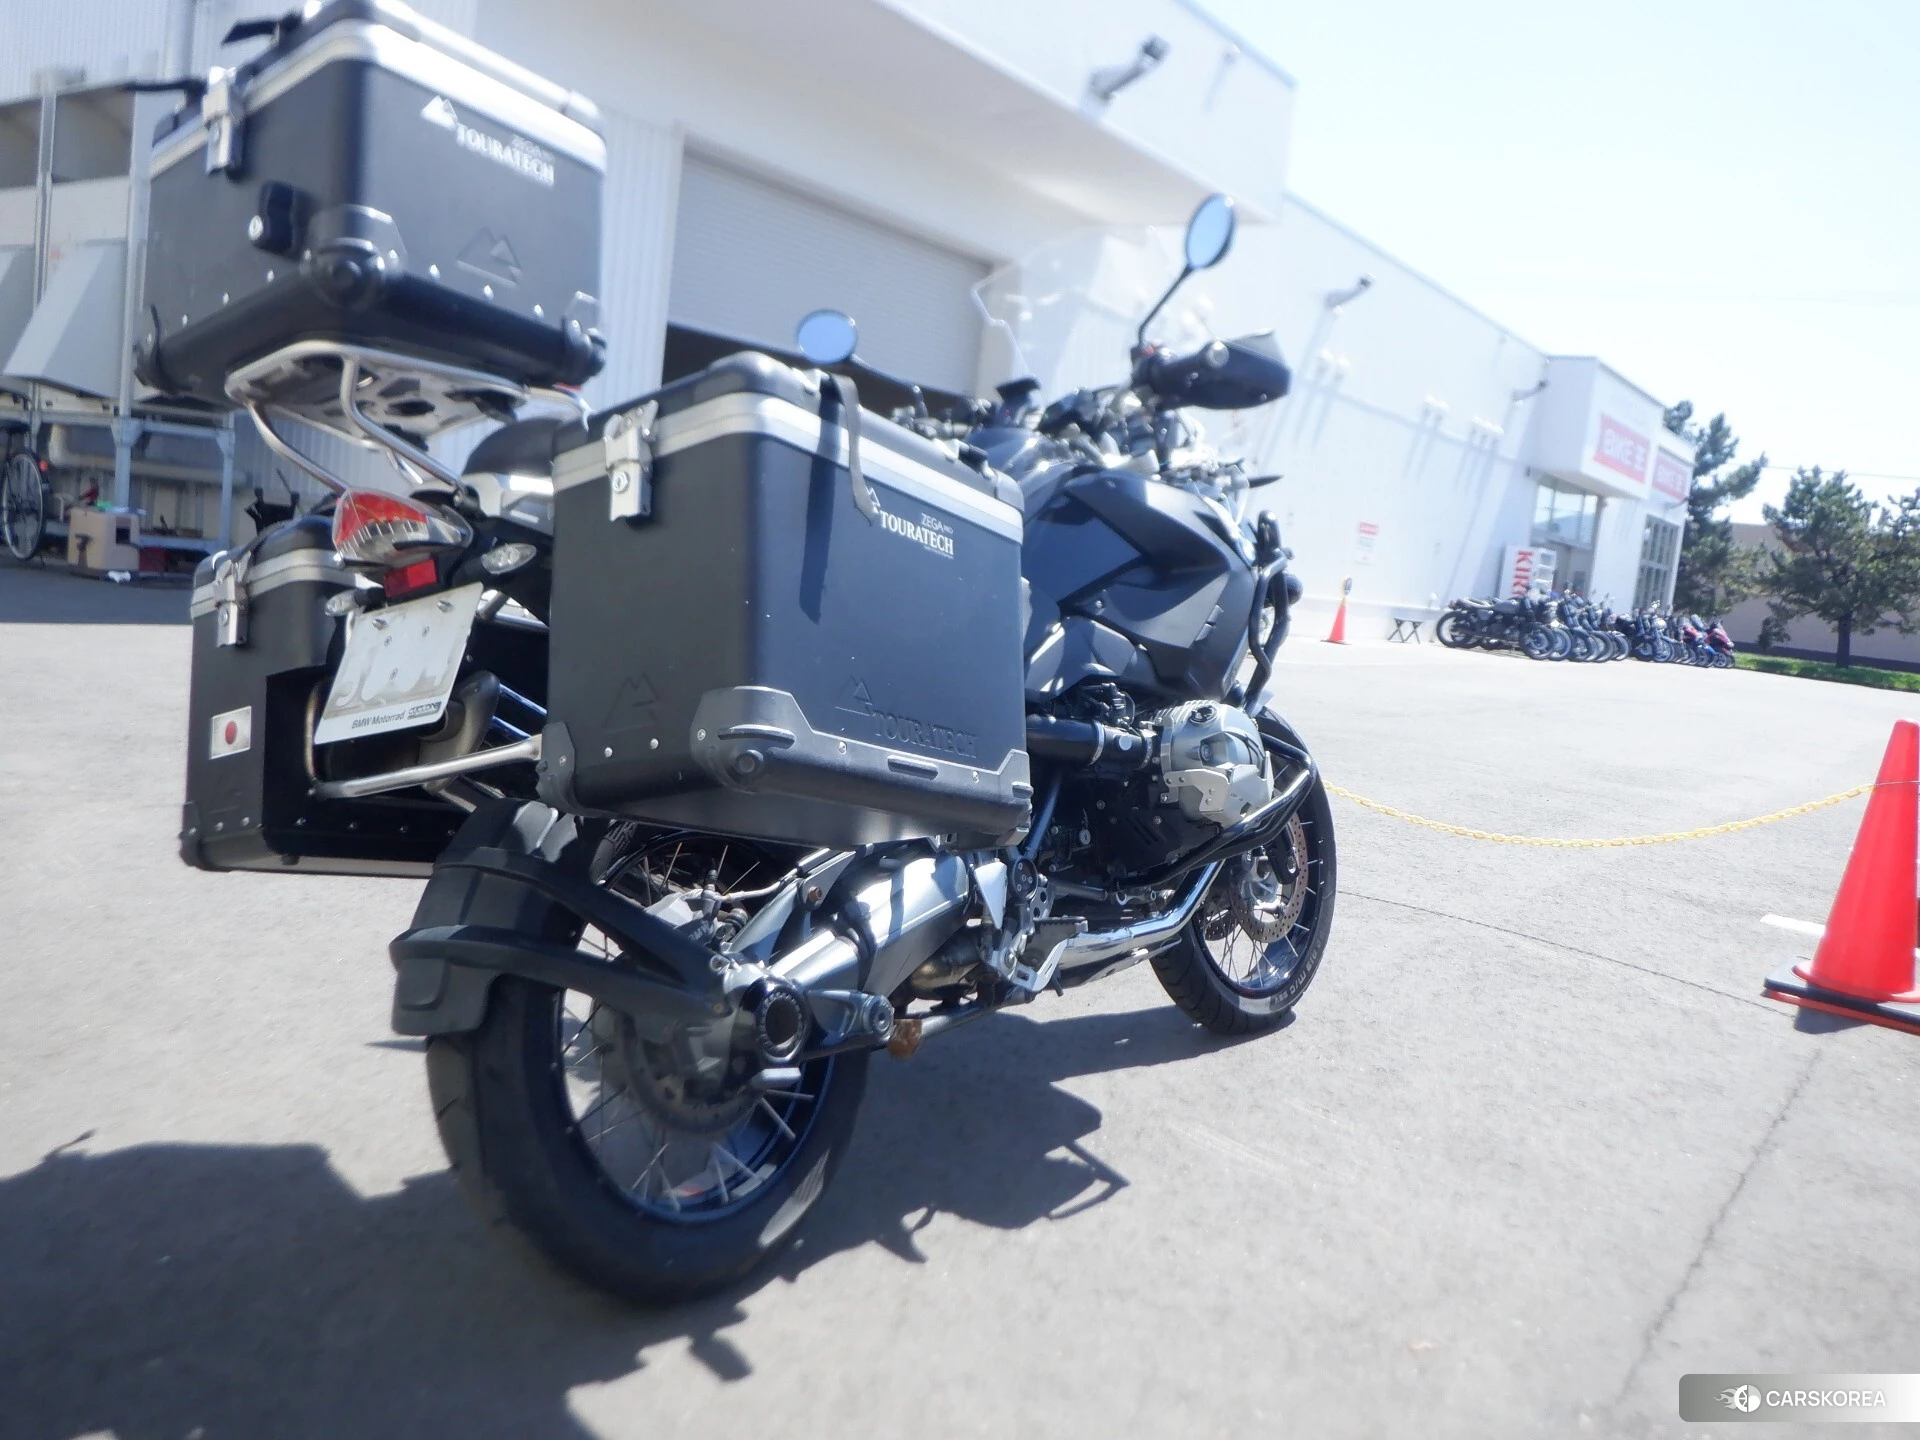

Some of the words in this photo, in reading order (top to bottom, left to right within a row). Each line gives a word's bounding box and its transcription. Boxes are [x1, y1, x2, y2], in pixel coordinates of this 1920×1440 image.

[456, 122, 555, 186] TOURATECH
[879, 509, 954, 555] TOURATECH
[921, 512, 944, 532] ZEGA
[351, 716, 373, 730] BMW
[372, 711, 406, 726] Motorrad
[872, 708, 979, 759] TOURATECH
